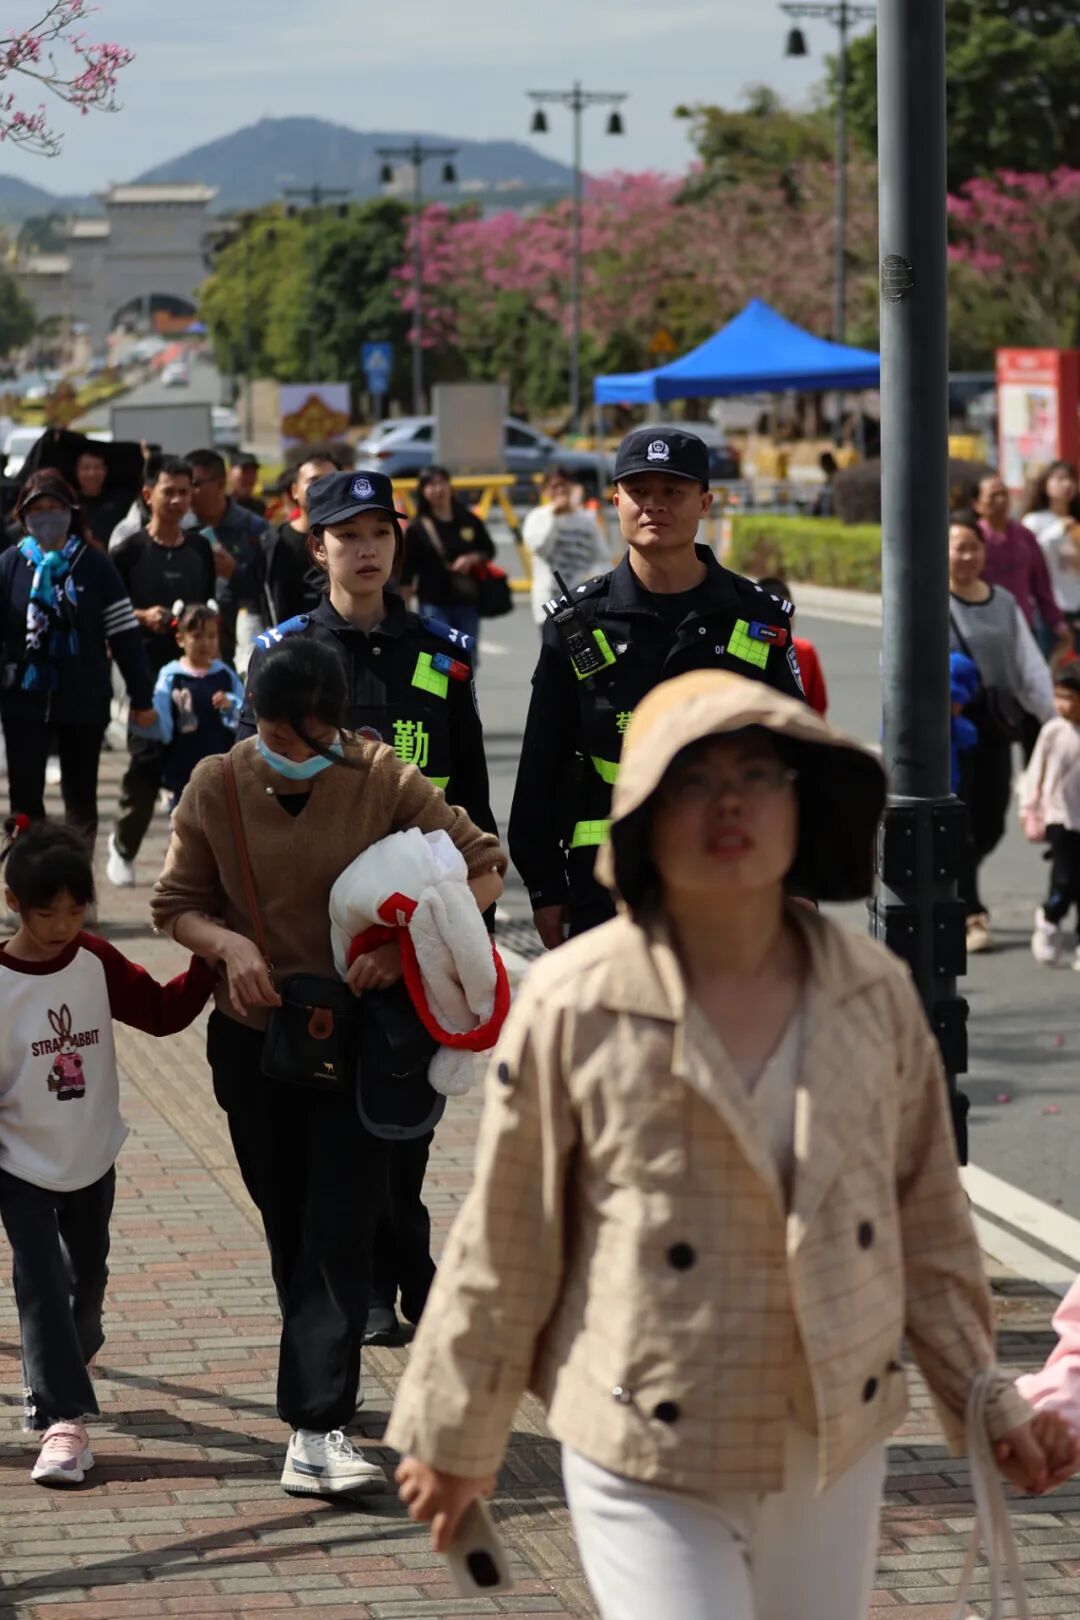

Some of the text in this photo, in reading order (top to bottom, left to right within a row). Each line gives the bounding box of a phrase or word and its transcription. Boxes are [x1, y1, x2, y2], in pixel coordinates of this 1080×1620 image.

[392, 719, 429, 768] 勤
[31, 1029, 99, 1057] STRA ABBIT
